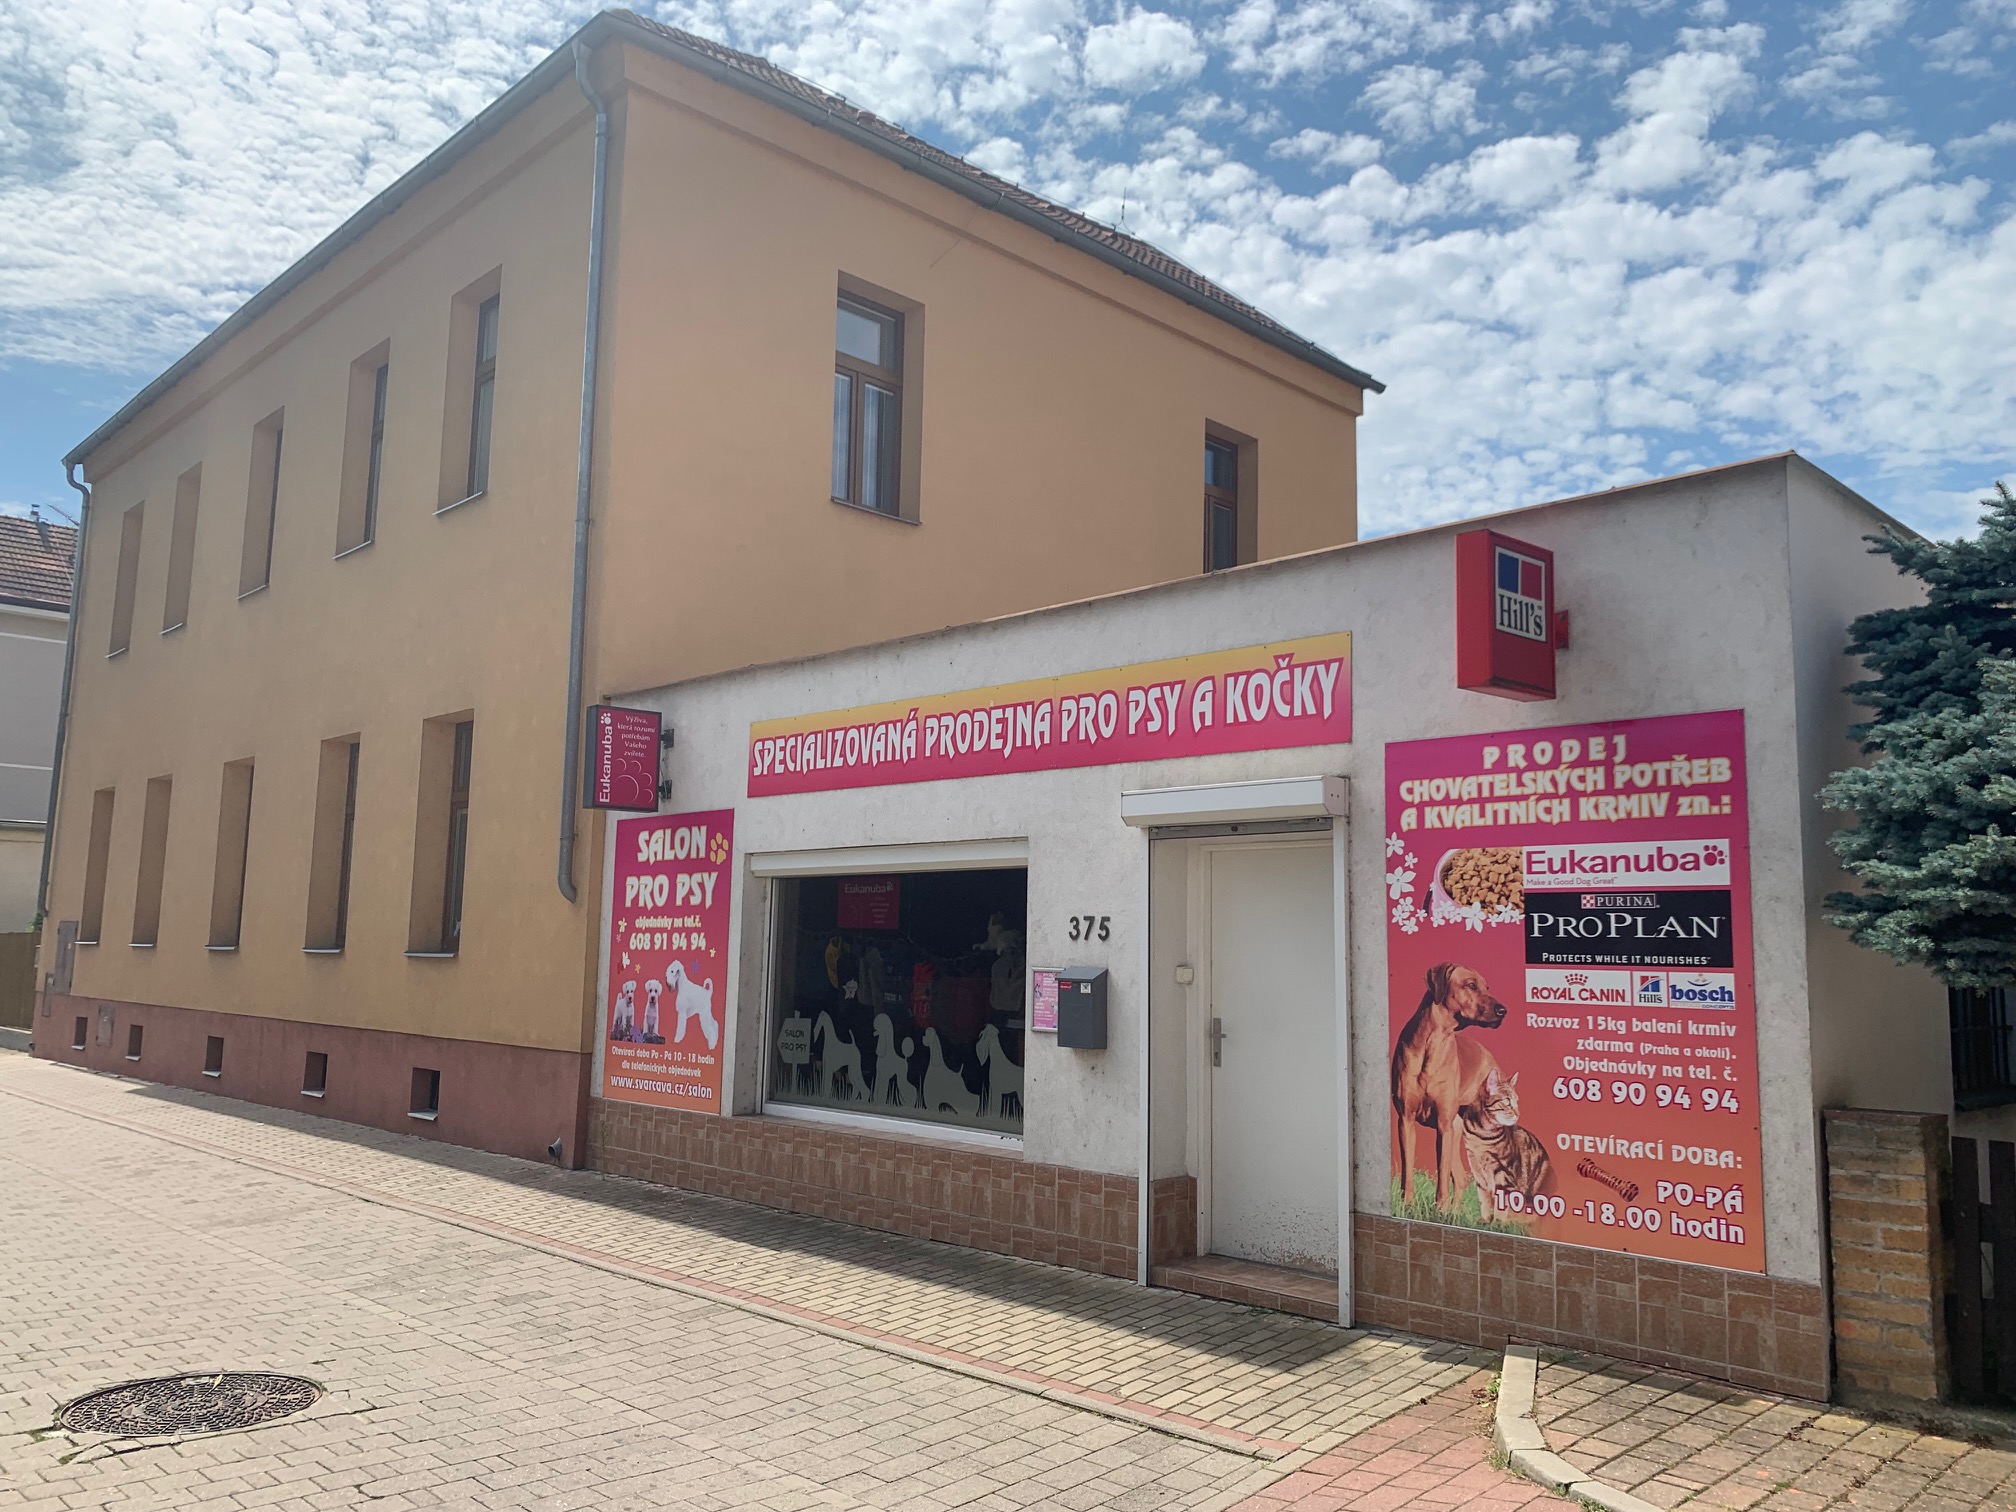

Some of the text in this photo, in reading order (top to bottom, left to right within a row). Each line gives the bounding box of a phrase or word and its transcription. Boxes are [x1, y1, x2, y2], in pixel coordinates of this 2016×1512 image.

[1498, 593, 1543, 637] Hill's
[617, 723, 633, 731] která
[753, 657, 1340, 776] SPECIALIZOVANÁ PRODEJNA PRO PSY A KOČKY
[621, 733, 650, 742] potřebám
[624, 741, 647, 750] Vašeho
[599, 726, 613, 803] Eukanuba
[1399, 753, 1732, 805] CHOVATELSKÝCH POTŘEB
[1400, 807, 1418, 832] A
[1424, 794, 1570, 830] KVALITNÍCH
[1578, 792, 1670, 822] KRMIV
[637, 825, 707, 866] SALON
[1525, 846, 1701, 875] Eukanuba
[625, 871, 719, 911] PRO PSY
[844, 883, 886, 893] Eukanuba
[1553, 878, 1574, 886] Good
[1576, 878, 1591, 887] Dog
[1597, 896, 1654, 907] PURINA
[635, 916, 673, 930] objednávky
[673, 917, 683, 928] na
[1068, 916, 1111, 941] 375
[629, 932, 707, 951] 608 91 94 94
[1542, 953, 1707, 965] PROTECTS WHILE IT NOURISHES
[1531, 986, 1626, 1003] ROYAL CANIN
[1639, 994, 1663, 1004] Hill's
[1670, 985, 1734, 1002] bosch
[784, 1029, 805, 1039] SALON
[1526, 1013, 1737, 1037] Rozvoz 15kg balení krmiv
[636, 1049, 650, 1059] doba
[651, 1050, 659, 1060] Po
[664, 1050, 672, 1061] Pá
[673, 1052, 682, 1062] 10
[688, 1053, 697, 1063] 18
[697, 1054, 715, 1065] hodin
[781, 1042, 808, 1052] PRO PSY
[1577, 1037, 1737, 1060] zdarma (Praha a okolí).
[621, 1060, 702, 1078] dle telefonických objednávek
[1563, 1056, 1738, 1082] Objednávky na tel. č.
[610, 1075, 713, 1099] www.svarcava.cz/salon
[1552, 1076, 1739, 1114] 608 90 94 94
[1556, 1132, 1743, 1169] OTEVÍRACÍ DOBA:
[1656, 1180, 1743, 1215] PO-PÁ
[1495, 1188, 1566, 1218] 10.00
[1670, 1212, 1745, 1244] hodin
